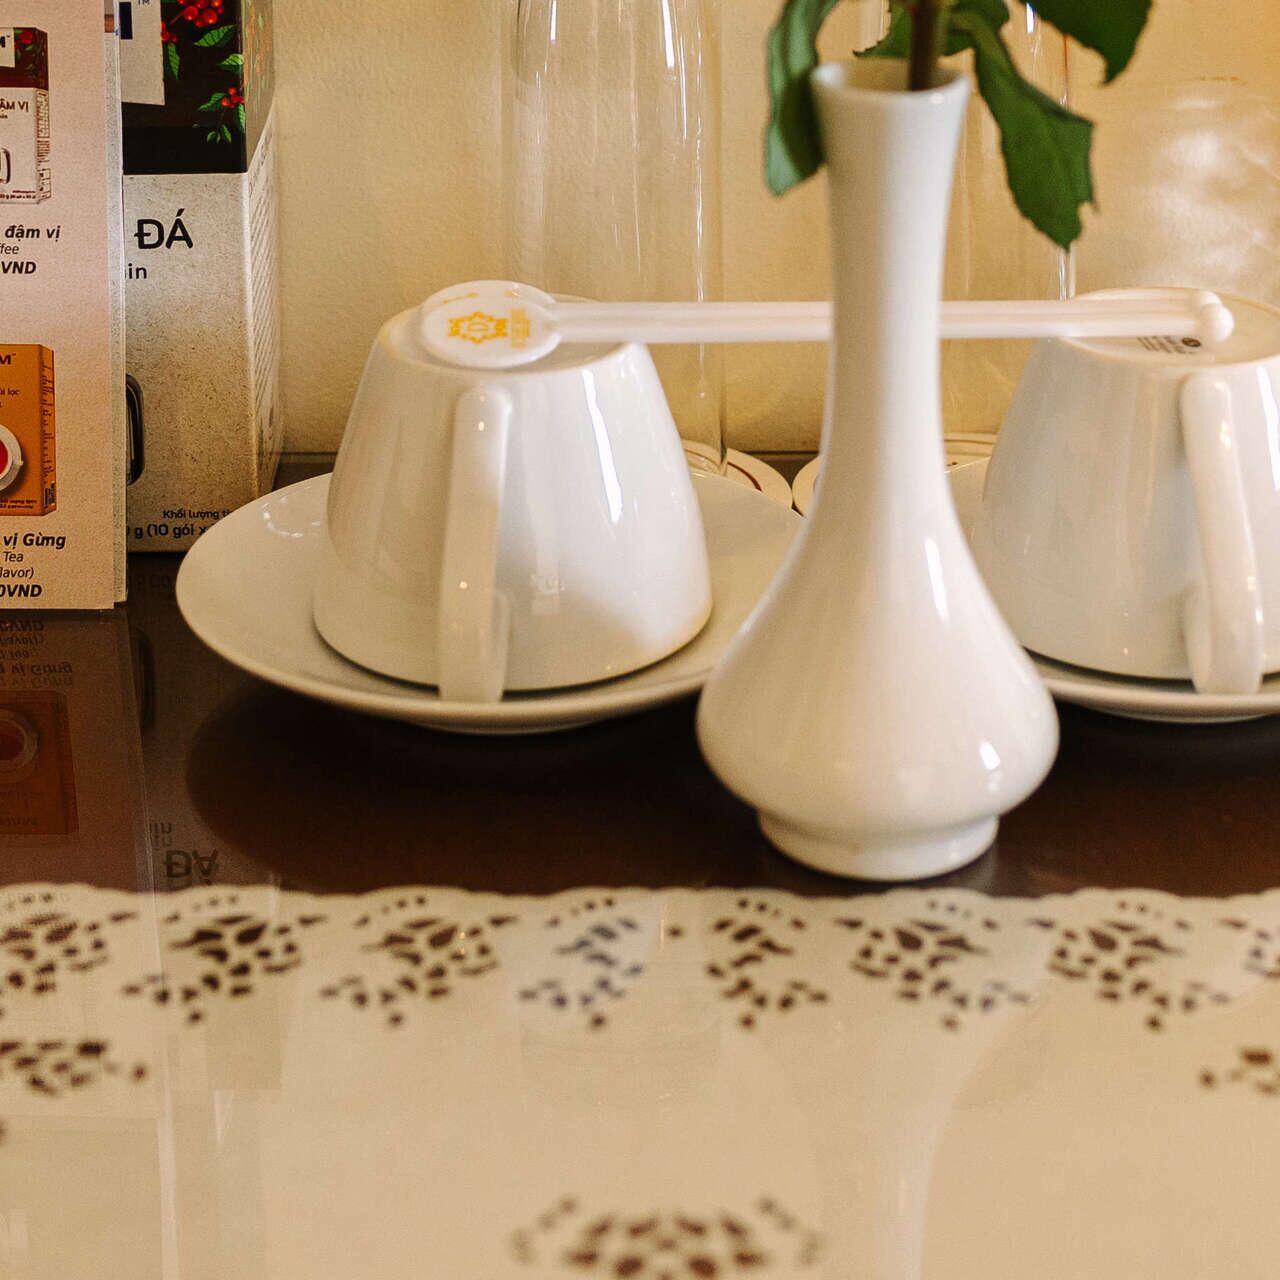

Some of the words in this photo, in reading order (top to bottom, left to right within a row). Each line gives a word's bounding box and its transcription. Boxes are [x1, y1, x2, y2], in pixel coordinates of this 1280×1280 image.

[5, 224, 40, 242] đậm
[46, 225, 62, 242] vị
[135, 207, 194, 249] ĐÁ
[163, 507, 186, 519] Khối
[189, 508, 219, 521] lượng
[3, 532, 18, 549] vị
[22, 532, 66, 550] Gừng
[3, 551, 24, 562] Tea
